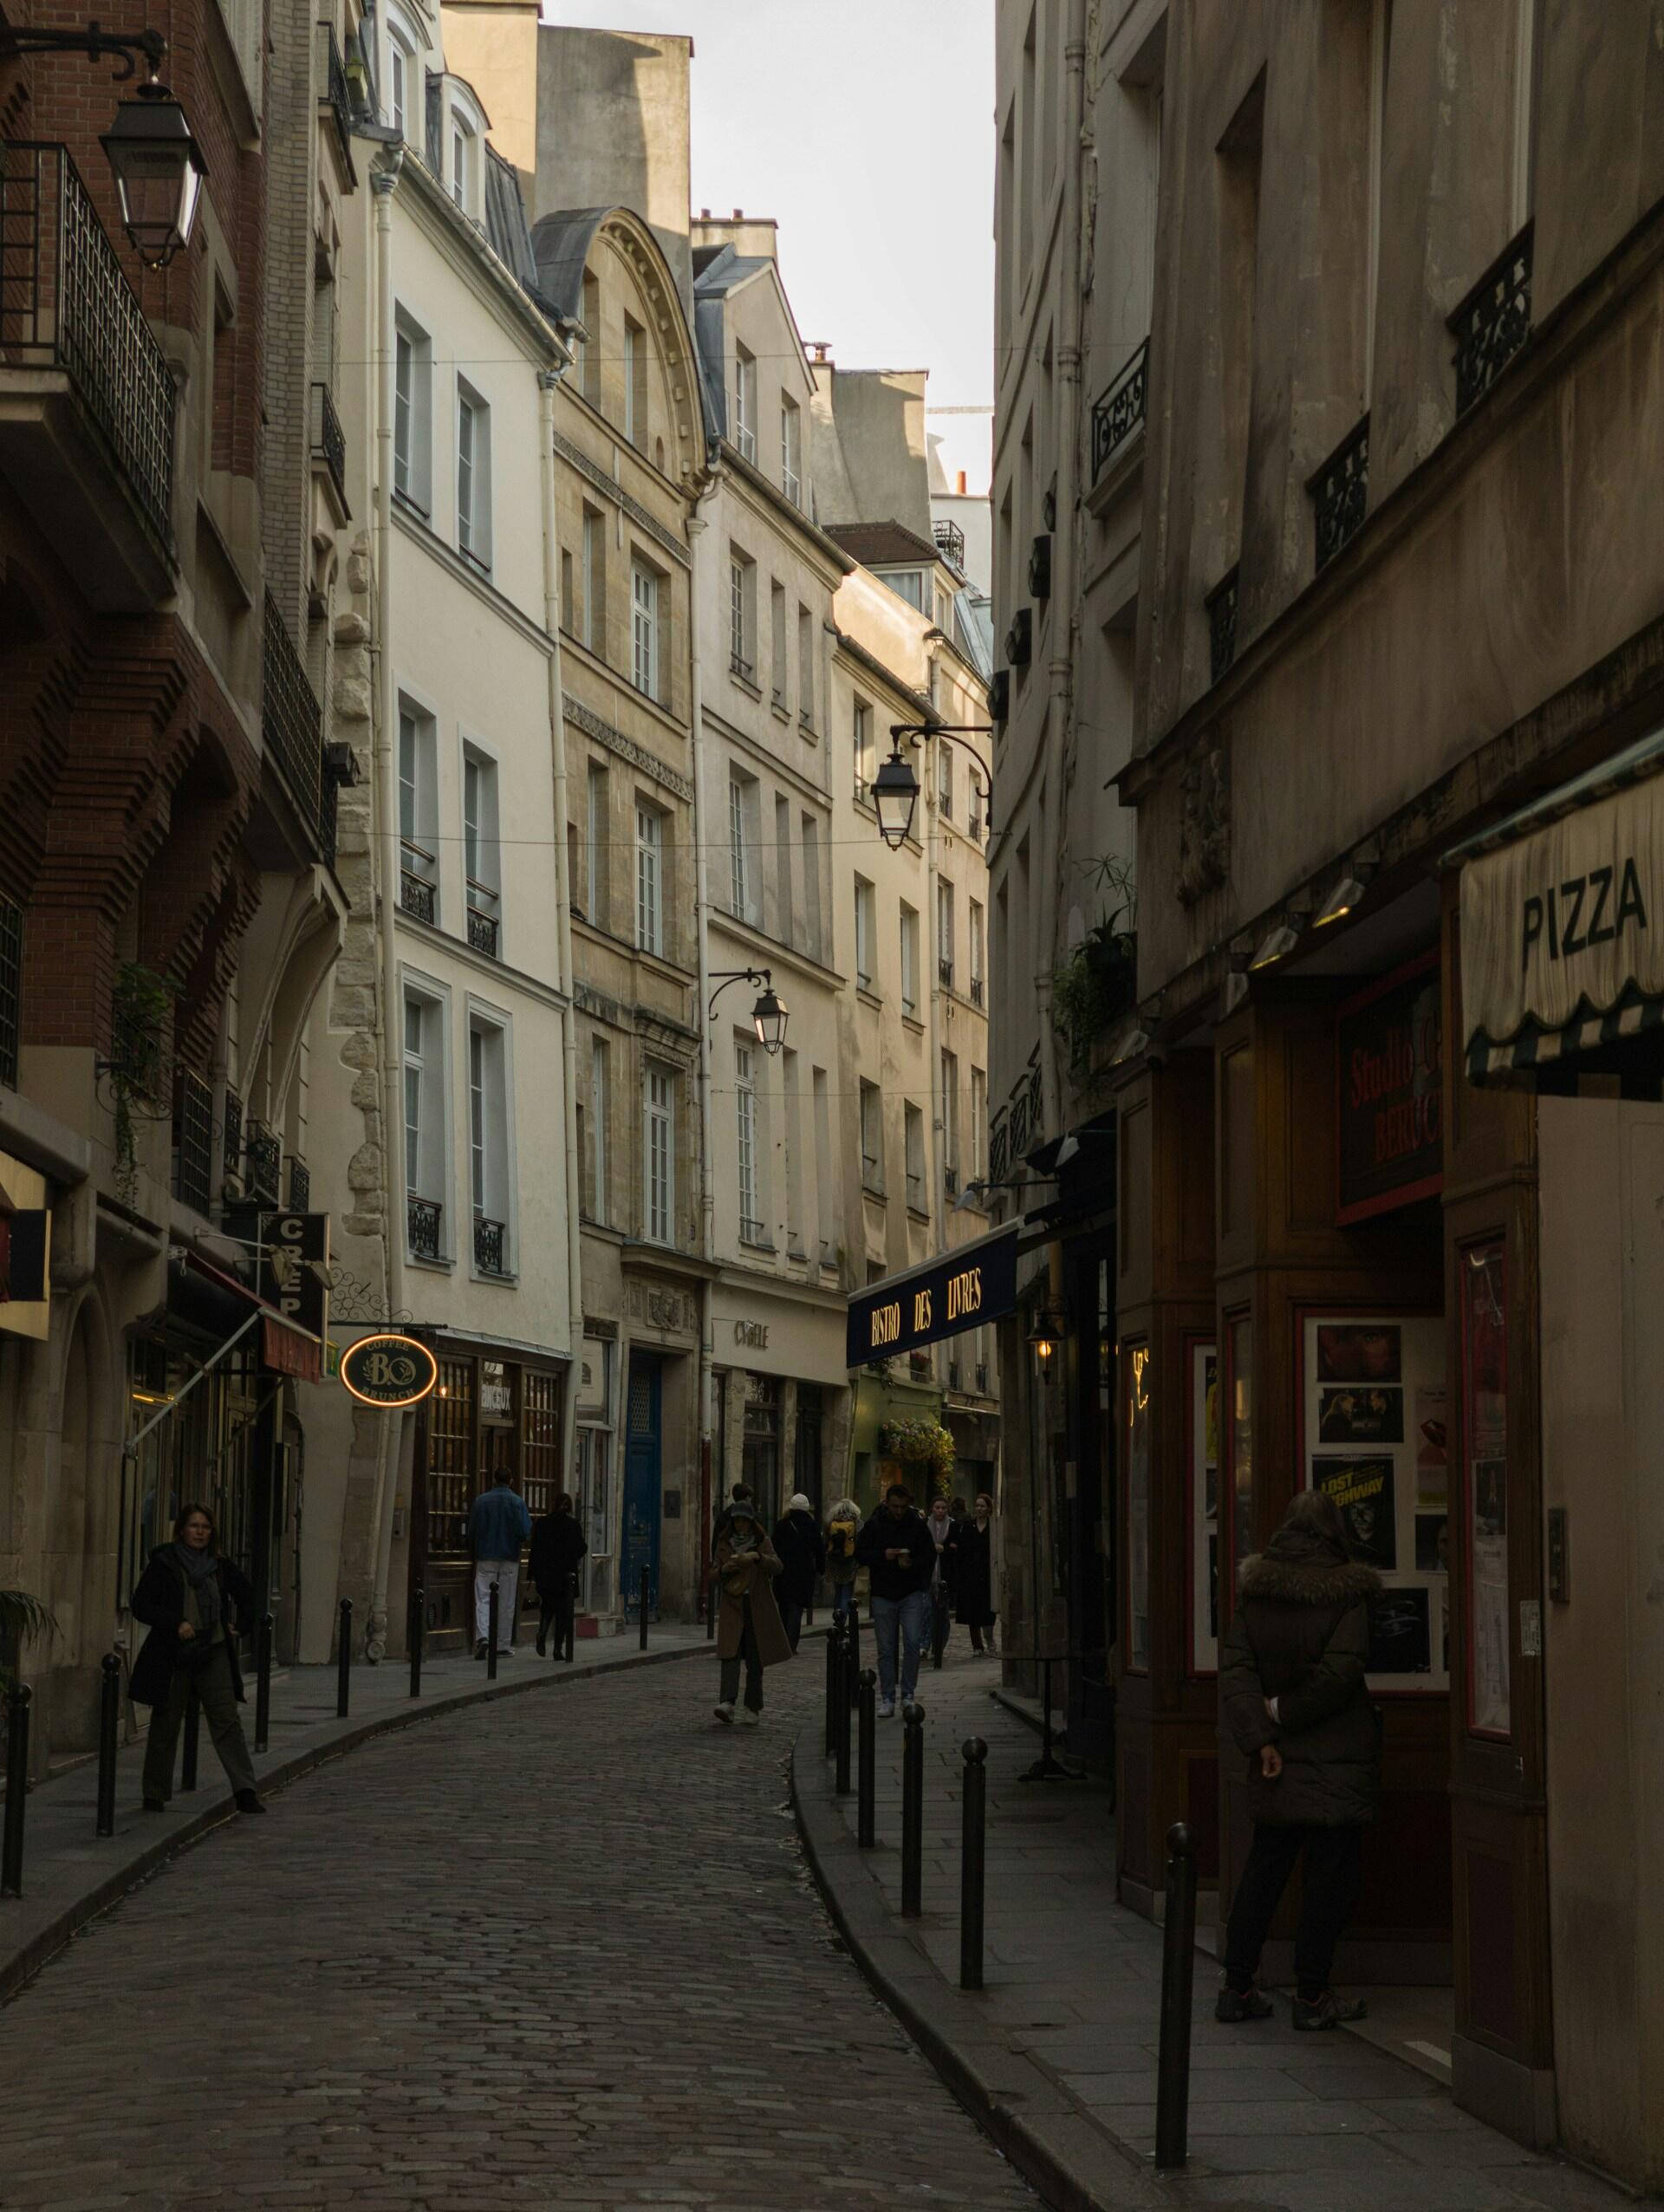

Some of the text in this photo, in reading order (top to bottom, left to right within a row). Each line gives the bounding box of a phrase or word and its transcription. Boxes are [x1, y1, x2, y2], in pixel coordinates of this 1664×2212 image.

[1522, 856, 1648, 972] PIZZA
[871, 1266, 983, 1347] BISTRO DES LIVRES
[366, 1339, 410, 1351] COFFEE
[361, 1386, 415, 1402] BRUNCH
[1319, 1471, 1355, 1495] LOST
